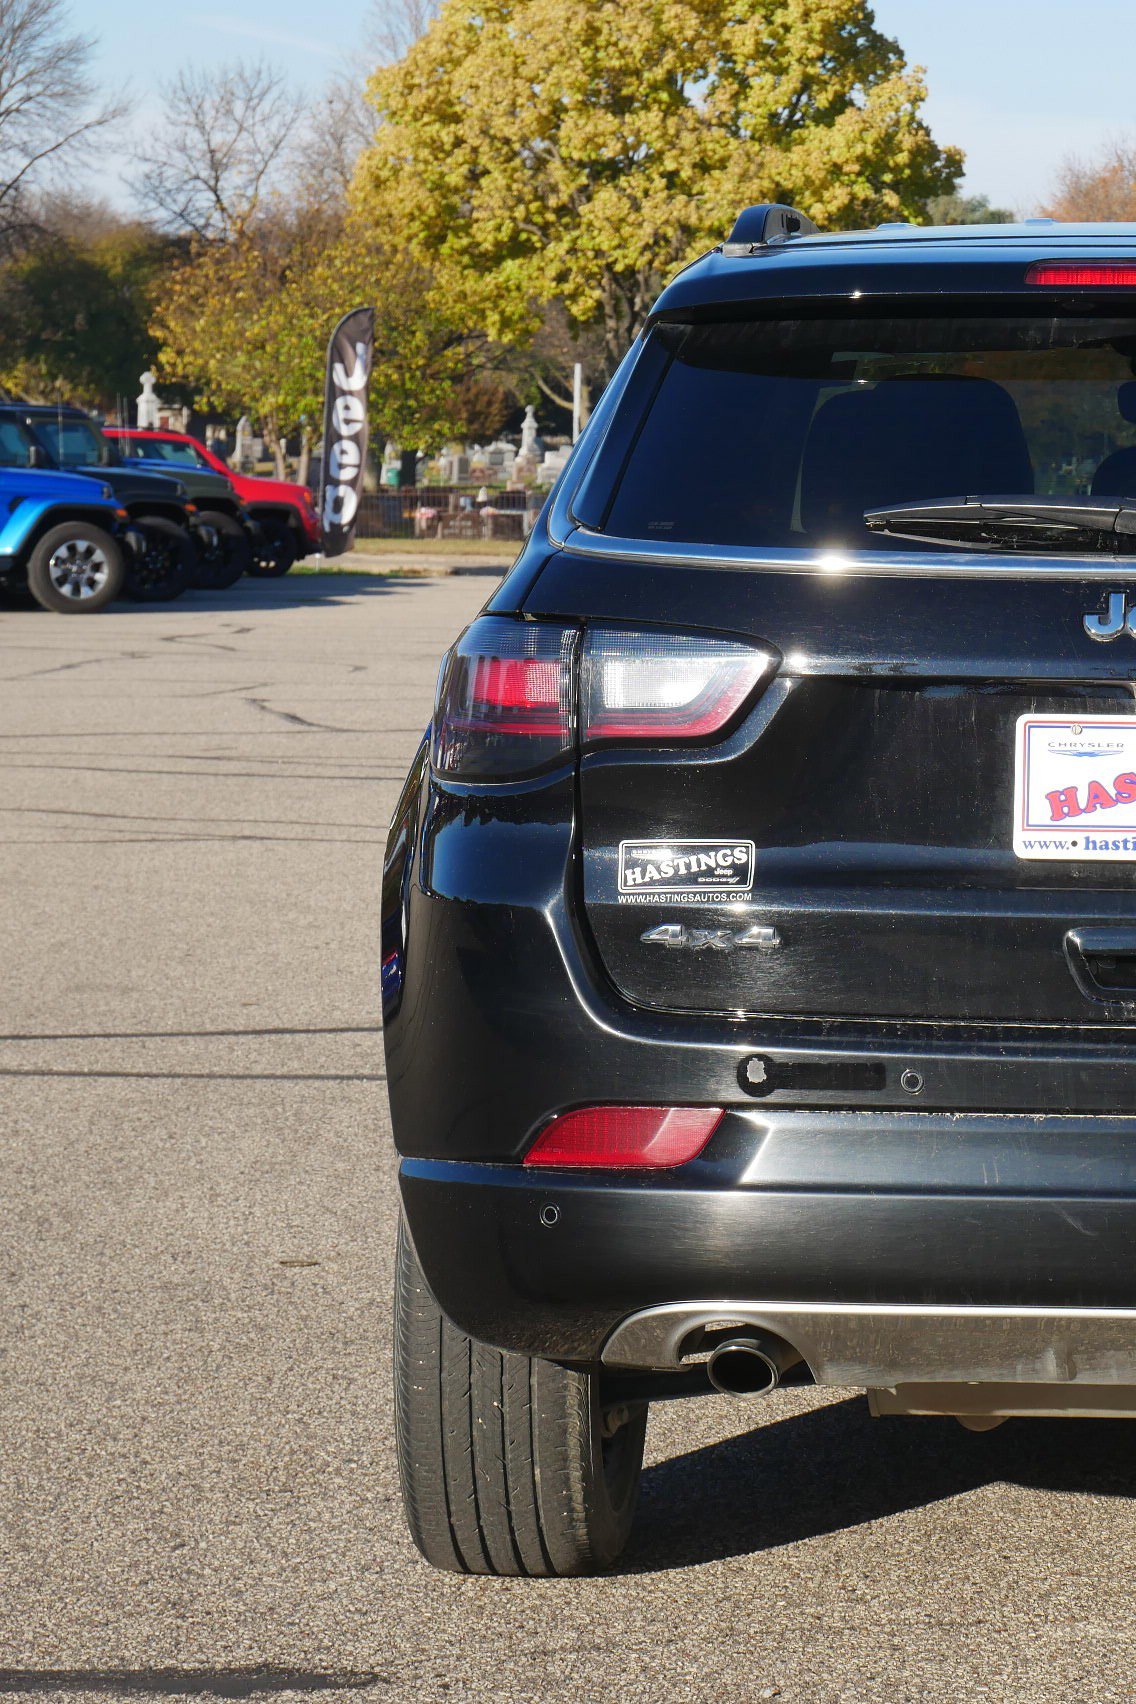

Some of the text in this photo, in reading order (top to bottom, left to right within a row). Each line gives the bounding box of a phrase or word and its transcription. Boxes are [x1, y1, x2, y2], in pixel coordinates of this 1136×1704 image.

[323, 342, 368, 533] Jeep
[625, 847, 748, 886] HASTINGS
[714, 868, 733, 876] Jeep
[618, 892, 752, 904] WWW.HASTINGSAUTOS.COM
